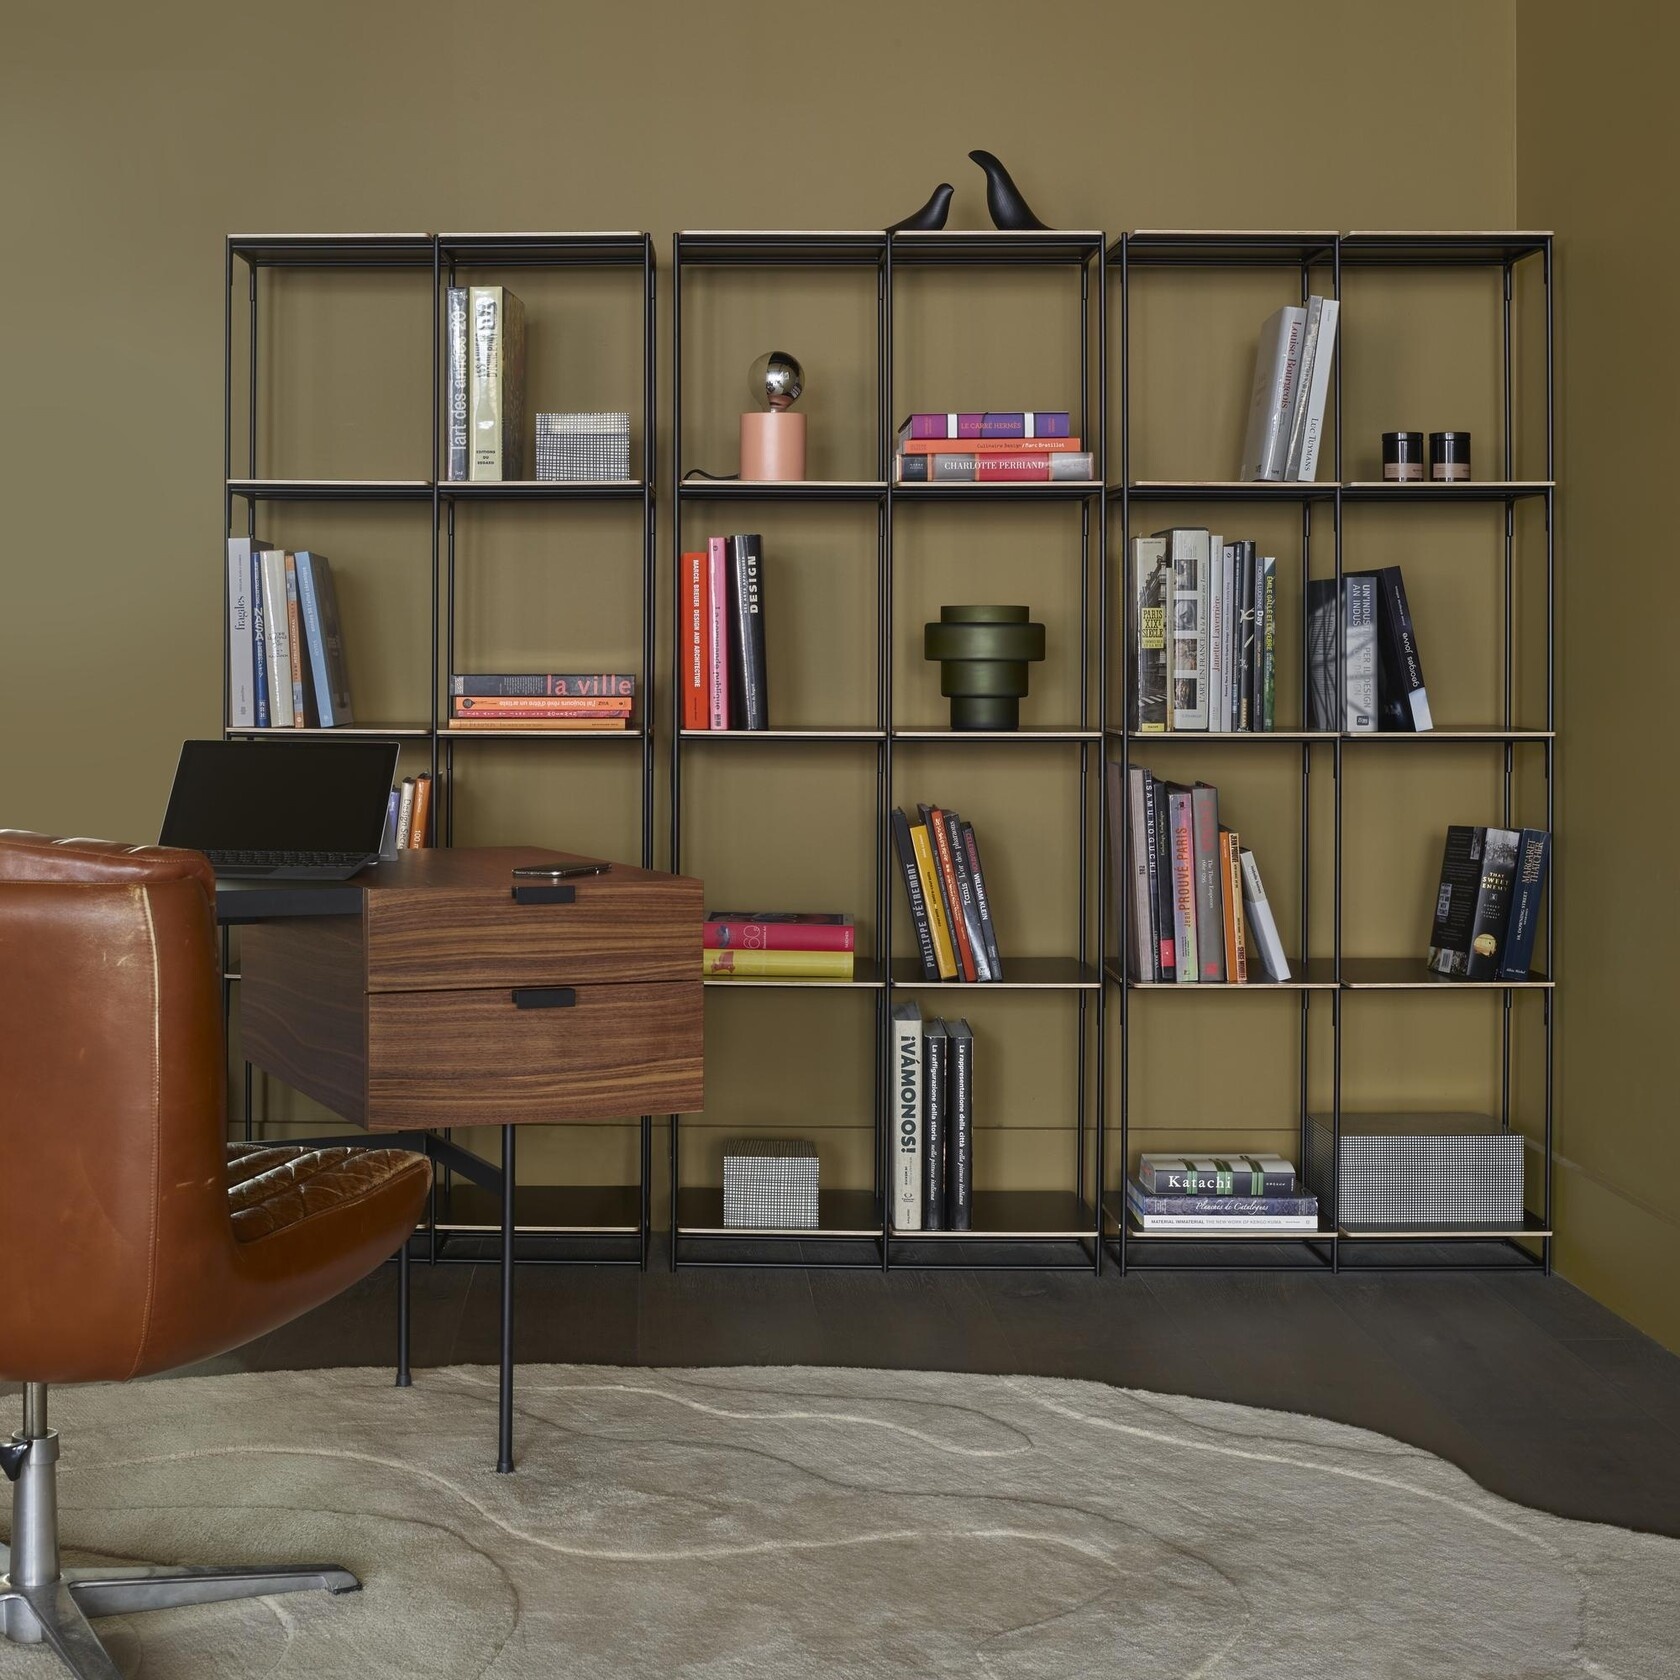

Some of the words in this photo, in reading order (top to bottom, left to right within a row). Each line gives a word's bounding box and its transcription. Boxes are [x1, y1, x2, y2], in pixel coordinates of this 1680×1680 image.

[1289, 321, 1302, 355] Louise
[1281, 358, 1296, 409] Bourgeois
[452, 394, 466, 420] des
[944, 461, 997, 470] CHARLOTTE
[999, 461, 1044, 470] PERRIAND
[747, 556, 759, 614] DESIGN
[1352, 584, 1361, 596] AN
[234, 595, 248, 630] fragiles
[254, 608, 264, 640] NASA
[1143, 610, 1163, 619] PARIS
[1255, 610, 1264, 626] Day
[1212, 642, 1220, 672] Janette
[1402, 632, 1413, 654] jouve
[546, 674, 568, 695] la
[578, 674, 631, 695] ville
[1199, 669, 1205, 680] EN
[1407, 656, 1420, 688] georges
[713, 672, 722, 710] publique
[1363, 677, 1371, 708] DESIGN
[400, 798, 412, 826] Design
[1146, 779, 1154, 816] ISAMU
[399, 828, 408, 849] Secre
[414, 830, 422, 842] 100
[949, 821, 962, 850] pharaons
[1148, 820, 1156, 873] NOGUCHI
[1175, 828, 1188, 861] PARIS
[1521, 838, 1536, 884] MARGARET
[1529, 842, 1544, 884] THATCHER
[906, 863, 924, 917] PÉTREMANT
[965, 832, 979, 873] CELEBRATION
[973, 872, 984, 900] WILLIAM
[980, 901, 988, 920] KLEIN
[1174, 866, 1190, 911] PROUVÉ
[1482, 876, 1508, 886] SWEET
[1482, 883, 1508, 891] ENEMY
[961, 882, 971, 906] Tanis
[919, 921, 935, 968] PHILIPPE
[932, 1044, 938, 1053] La
[959, 1045, 965, 1053] La
[930, 1054, 938, 1102] raffigurazione
[900, 1035, 920, 1154] ¡VÁMONOS!
[957, 1162, 966, 1182] pittura
[1168, 1175, 1231, 1189] Katachi
[1195, 1199, 1224, 1210] Planches
[1224, 1199, 1233, 1210] de
